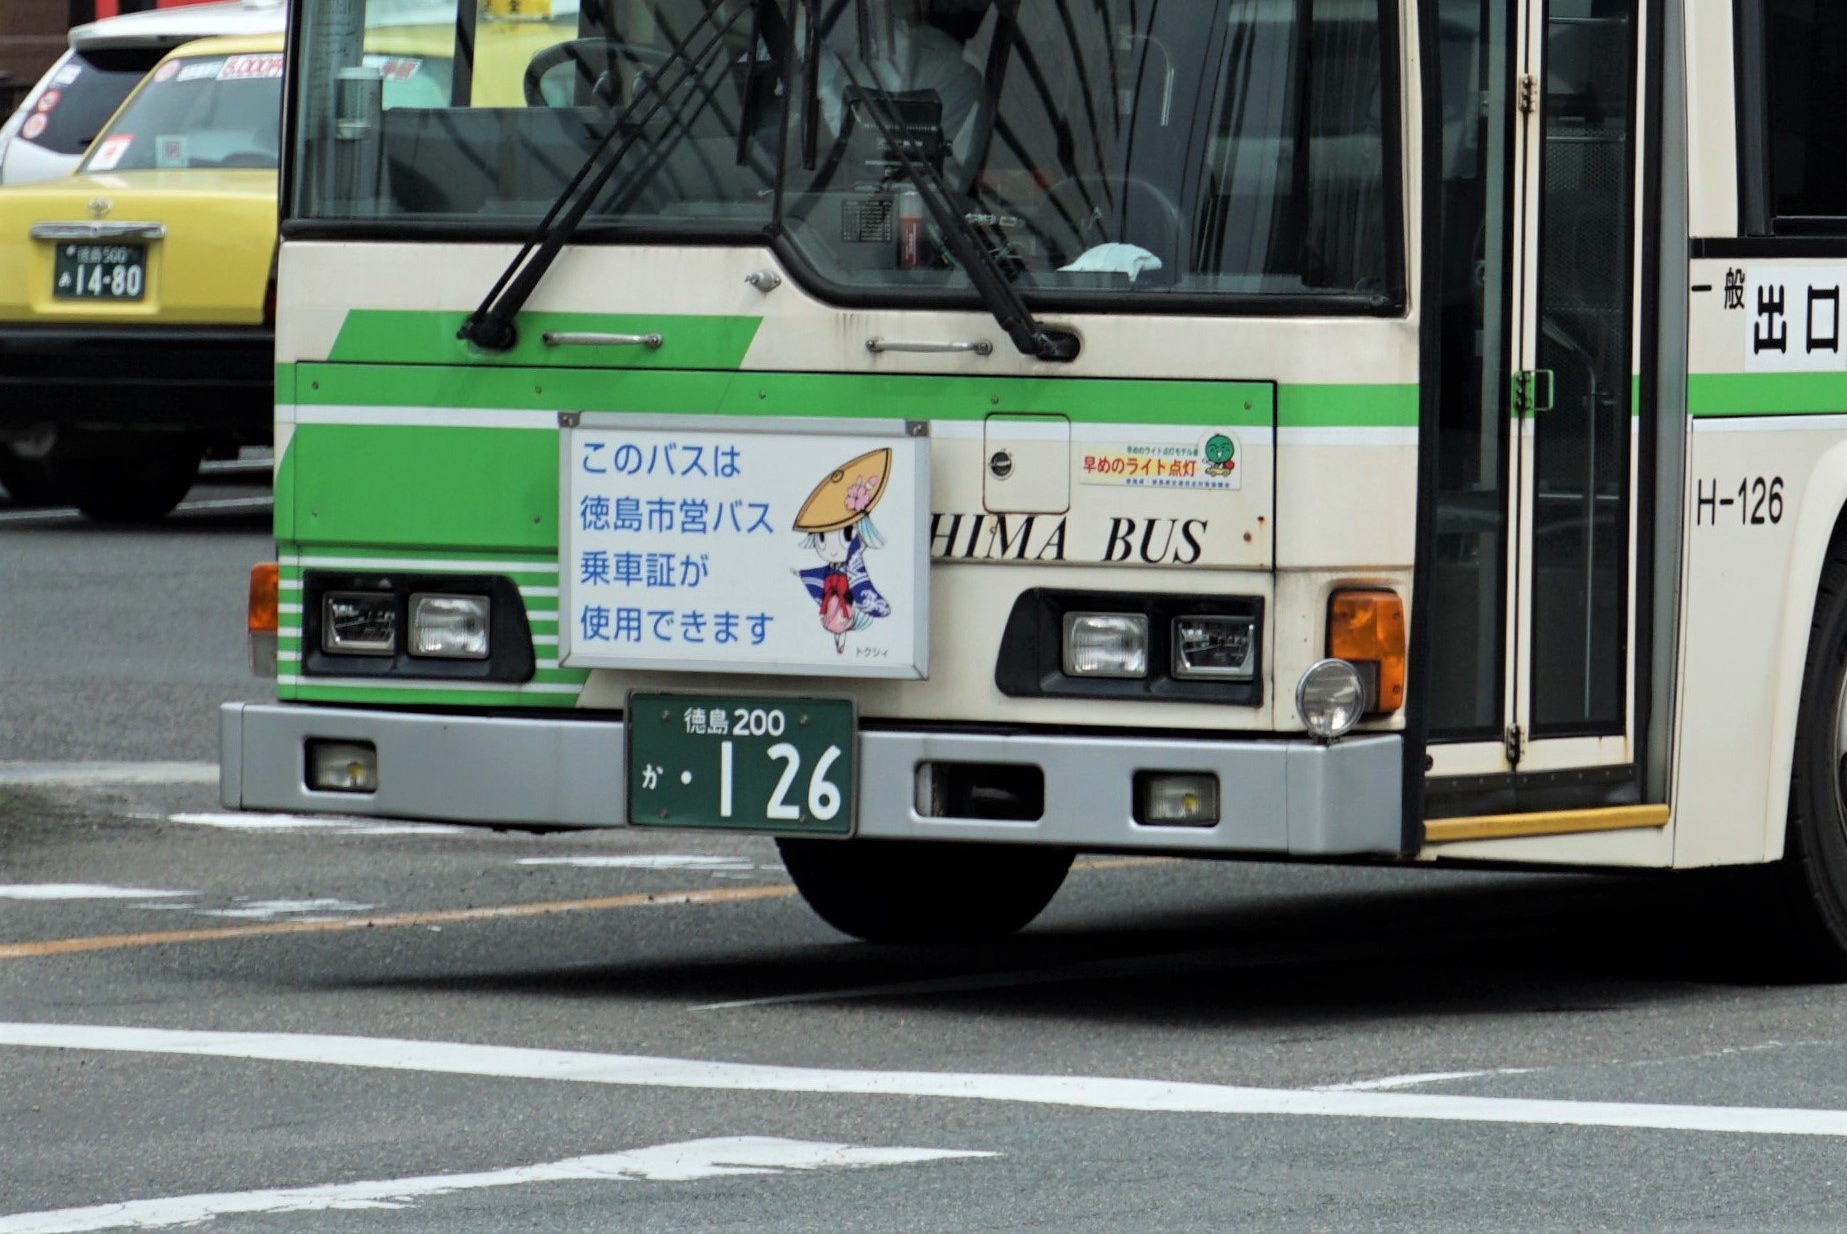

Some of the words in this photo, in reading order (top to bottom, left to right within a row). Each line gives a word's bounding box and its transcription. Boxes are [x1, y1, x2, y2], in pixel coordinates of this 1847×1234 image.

[76, 264, 143, 297] 14-80
[1690, 267, 1746, 310] 一般
[1754, 284, 1840, 355] 出口
[581, 441, 741, 477] このバスは
[1083, 455, 1198, 478] 早めのライト点灯
[580, 495, 775, 535] 徳島市営バス
[1697, 476, 1784, 526] H-126
[1100, 516, 1209, 565] BUS
[580, 550, 709, 589] 乗車証が
[580, 604, 774, 646] 使用できます
